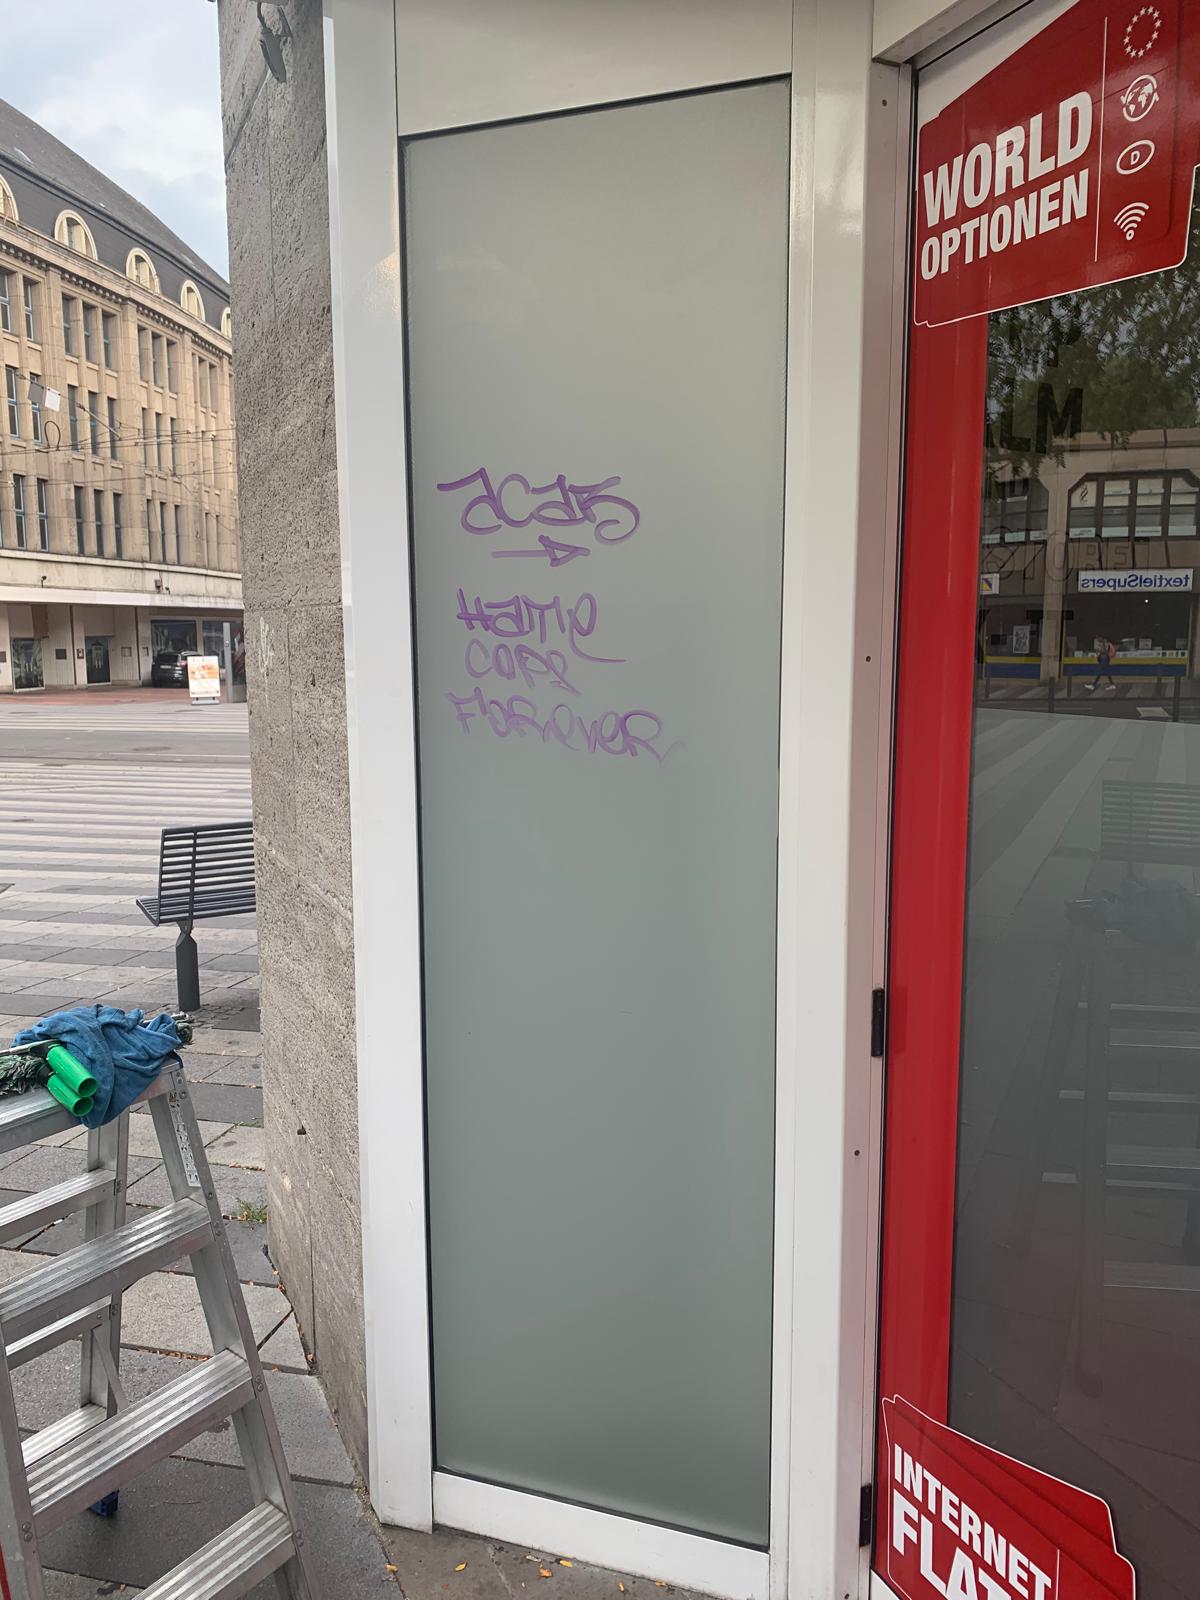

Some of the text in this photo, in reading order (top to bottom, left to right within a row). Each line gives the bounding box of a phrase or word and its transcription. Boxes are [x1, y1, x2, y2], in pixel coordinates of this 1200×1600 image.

[923, 91, 1093, 228] WORLD
[1131, 150, 1140, 165] D
[921, 168, 1090, 280] OPTIONEN
[894, 1443, 1052, 1600] INTERNET
